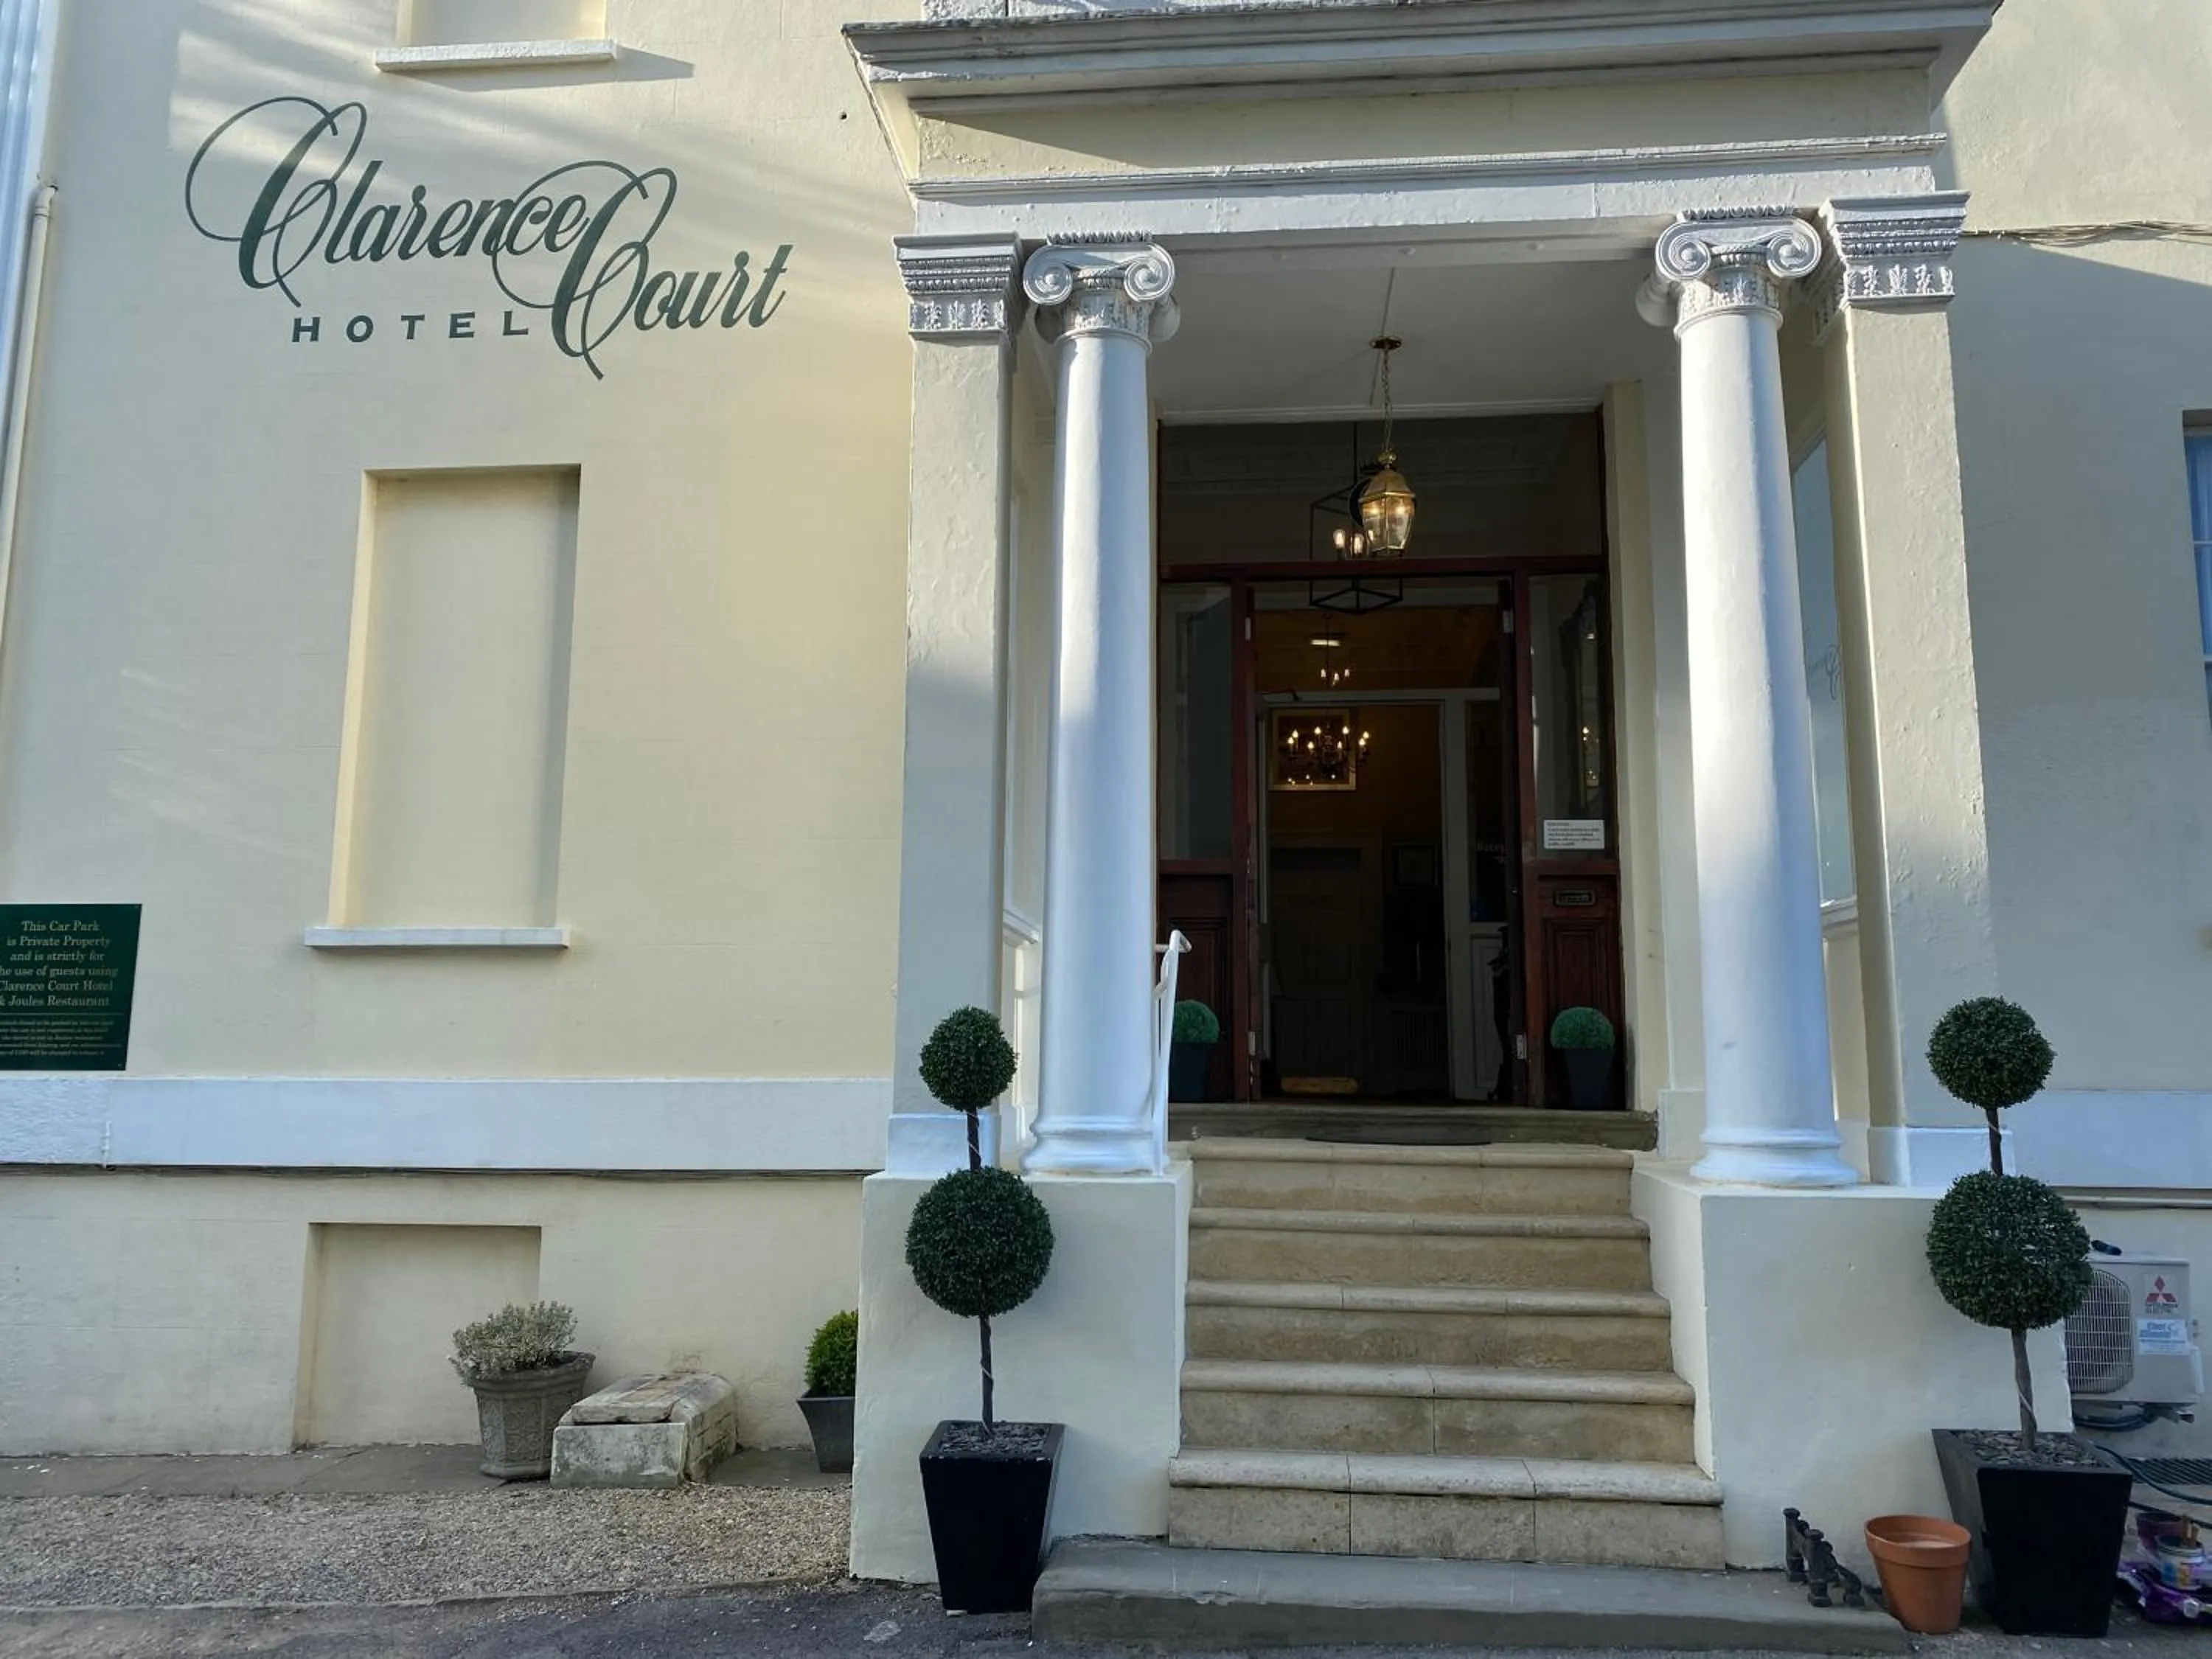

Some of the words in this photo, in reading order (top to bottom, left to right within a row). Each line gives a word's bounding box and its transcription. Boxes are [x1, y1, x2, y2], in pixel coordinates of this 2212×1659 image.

[186, 97, 589, 307] Clarence
[492, 160, 794, 380] Court
[292, 310, 529, 343] HOTEL
[21, 920, 46, 931] This
[49, 920, 70, 931] Car
[72, 920, 100, 931] Park
[7, 936, 16, 946] is
[19, 935, 60, 946] Private
[63, 935, 111, 948] Property
[10, 950, 32, 961] and
[34, 950, 44, 961] is
[46, 950, 86, 963] strictly
[89, 950, 105, 961] for
[0, 965, 12, 976] he
[14, 968, 33, 976] use
[35, 965, 49, 976] of
[49, 967, 86, 978] guests
[88, 967, 119, 978] using
[48, 980, 79, 992] Court
[83, 980, 114, 992] Hotel
[9, 995, 44, 1006] Joules
[47, 995, 110, 1006] Restaurant
